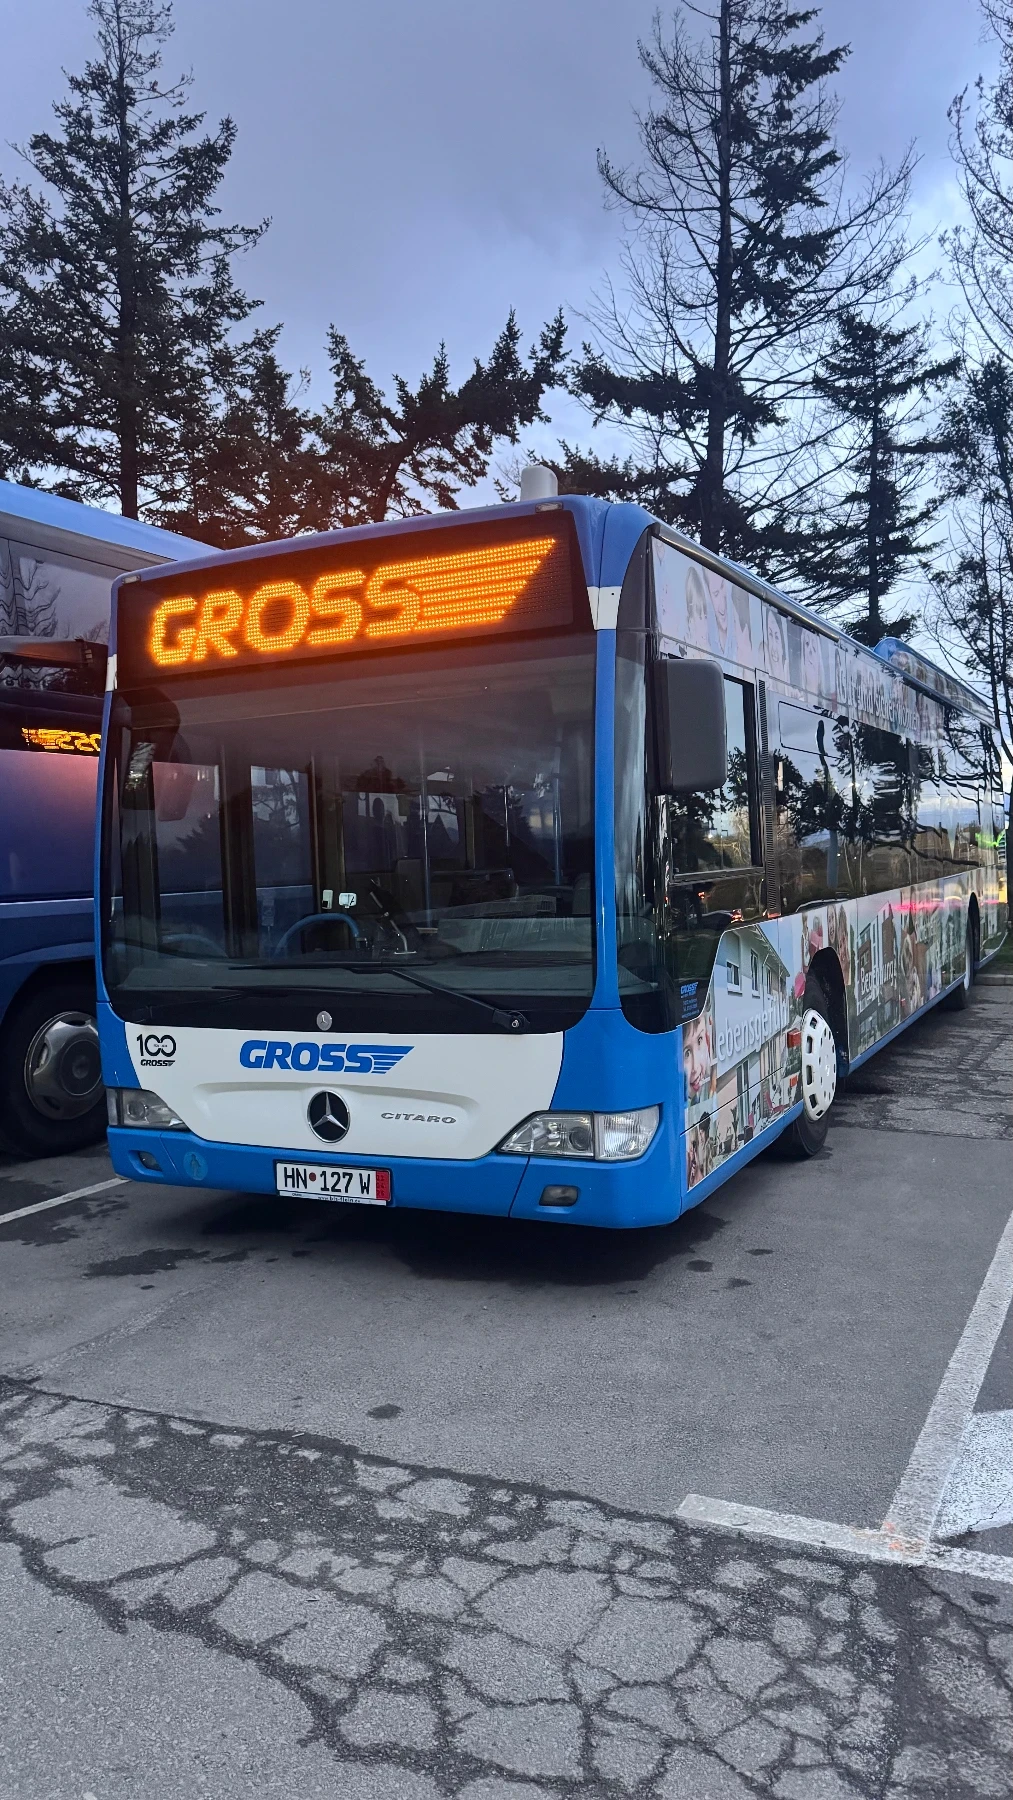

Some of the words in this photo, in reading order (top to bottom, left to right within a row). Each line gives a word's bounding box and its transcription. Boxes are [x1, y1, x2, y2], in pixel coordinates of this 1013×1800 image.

[149, 537, 556, 666] GROSS
[136, 1034, 177, 1057] 100
[239, 1039, 415, 1074] GROSS
[140, 1059, 175, 1067] GROSS
[380, 1112, 457, 1125] CITARO
[283, 1166, 308, 1190] HN
[319, 1170, 354, 1194] 127
[359, 1173, 371, 1195] W
